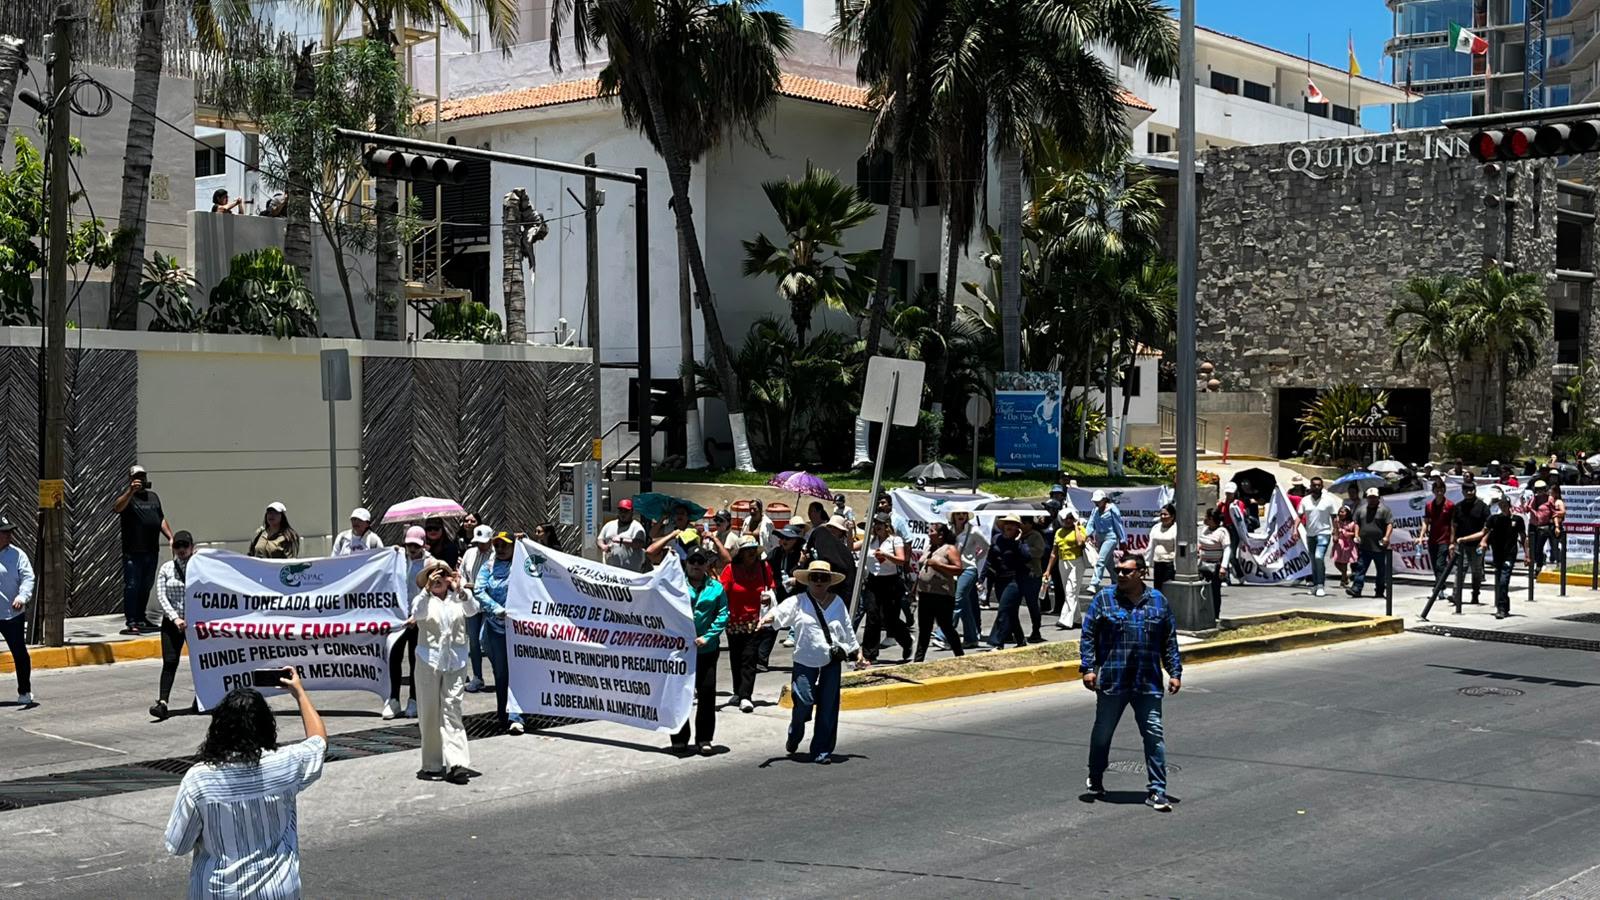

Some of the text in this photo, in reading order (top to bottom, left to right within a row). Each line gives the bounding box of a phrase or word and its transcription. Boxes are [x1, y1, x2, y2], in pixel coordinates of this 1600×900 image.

[1287, 139, 1408, 180] QUIJOTE
[1346, 426, 1400, 438] ROCINANTE
[243, 595, 310, 610] TONELADA
[315, 595, 340, 613] QUE
[344, 592, 399, 609] INGRESA
[532, 601, 541, 614] EL
[545, 601, 587, 620] INGRESO
[588, 606, 602, 621] DE
[644, 615, 665, 629] CON
[195, 621, 296, 640] DESTRUYE
[512, 620, 689, 653] RIESGO SANITARIO CONFIRMADO,
[199, 648, 246, 670] HUNDE
[249, 645, 308, 661] PRECIOS
[311, 644, 319, 655] Y
[514, 644, 687, 675] IGNORANDO EL PRINCIPIO PRECAUTORIO
[549, 669, 651, 696] Y PONIENDO EN PELIGRO
[541, 692, 659, 722] LA SOBERANÍA ALIMENTARIA
